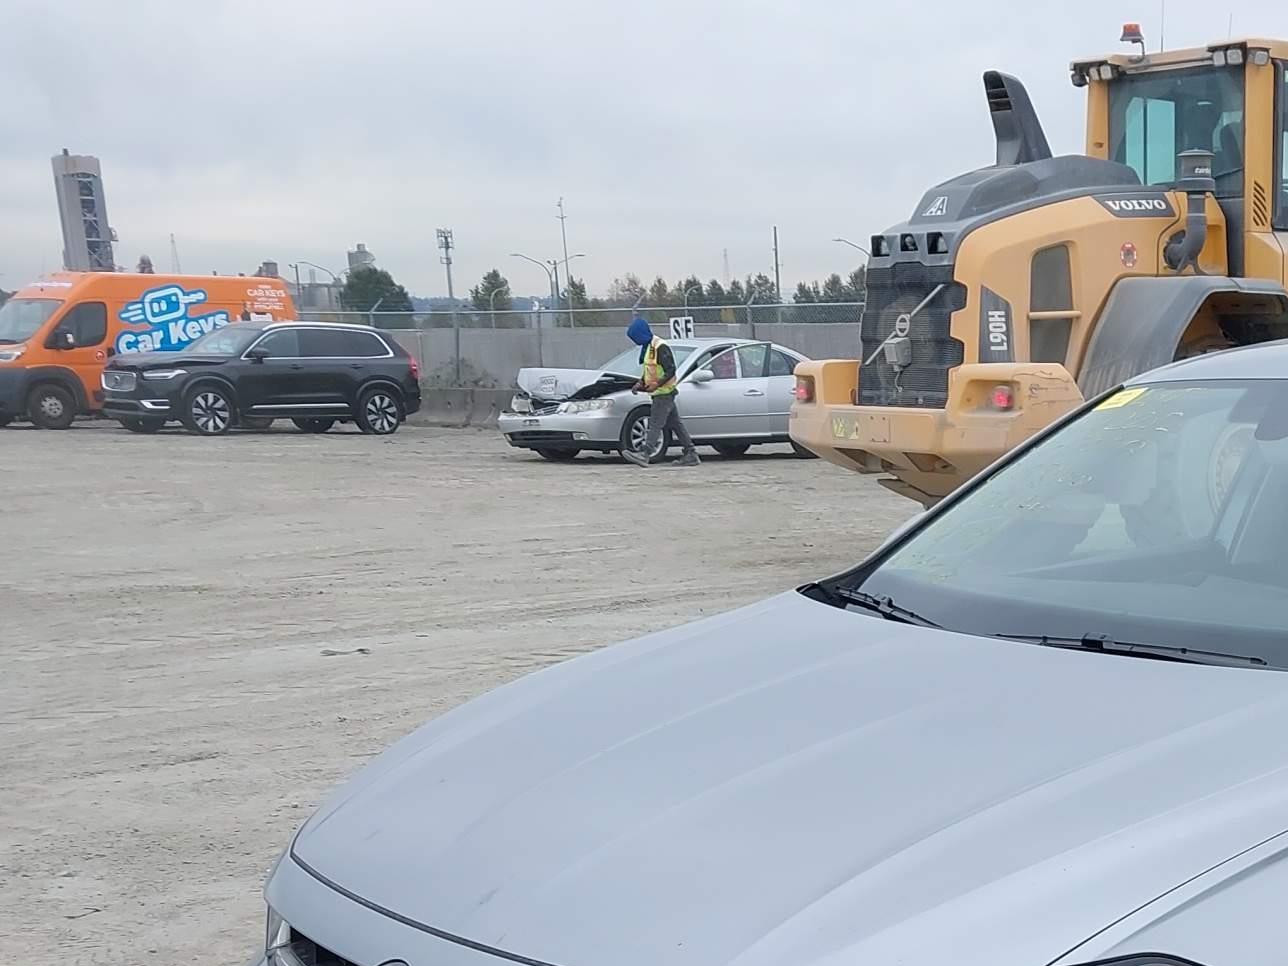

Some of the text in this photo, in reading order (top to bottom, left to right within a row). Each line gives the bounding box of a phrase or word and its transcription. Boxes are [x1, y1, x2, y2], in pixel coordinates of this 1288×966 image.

[1105, 200, 1167, 210] VOLVO
[118, 330, 164, 354] Car
[988, 310, 1008, 351] L90H
